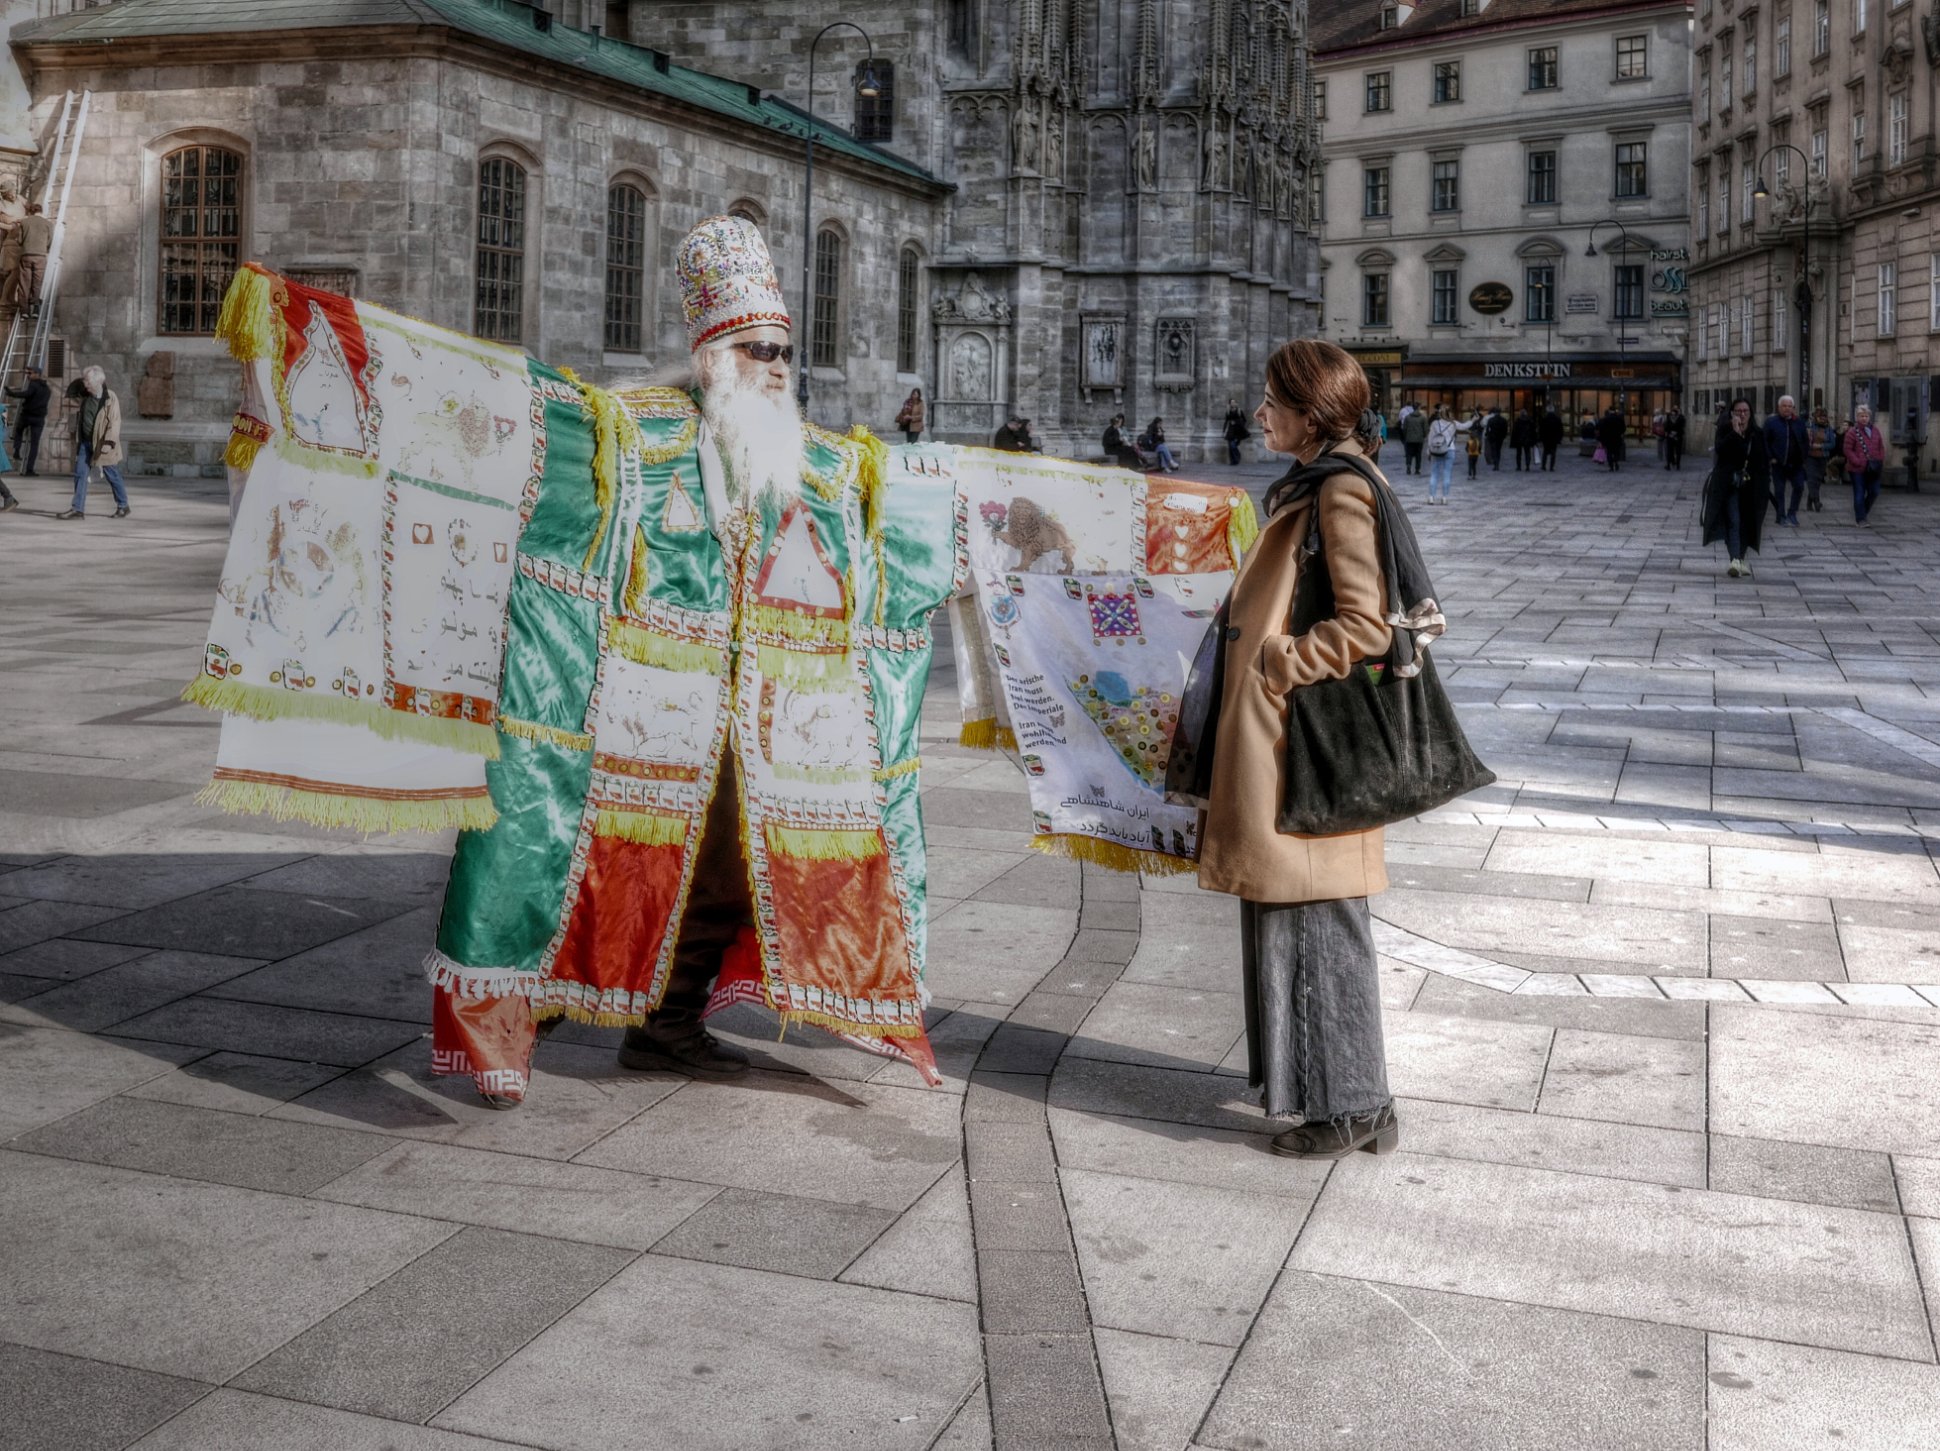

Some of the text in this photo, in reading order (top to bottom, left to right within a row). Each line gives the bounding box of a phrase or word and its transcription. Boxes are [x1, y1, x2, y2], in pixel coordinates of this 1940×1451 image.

[1650, 248, 1690, 262] hairst
[1650, 298, 1690, 312] beaut
[1484, 363, 1571, 378] DENKSTEIN
[1008, 683, 1043, 695] Iran muss
[1018, 721, 1036, 730] Iran
[1127, 803, 1150, 821] ایران
[1130, 831, 1150, 844] آباد
